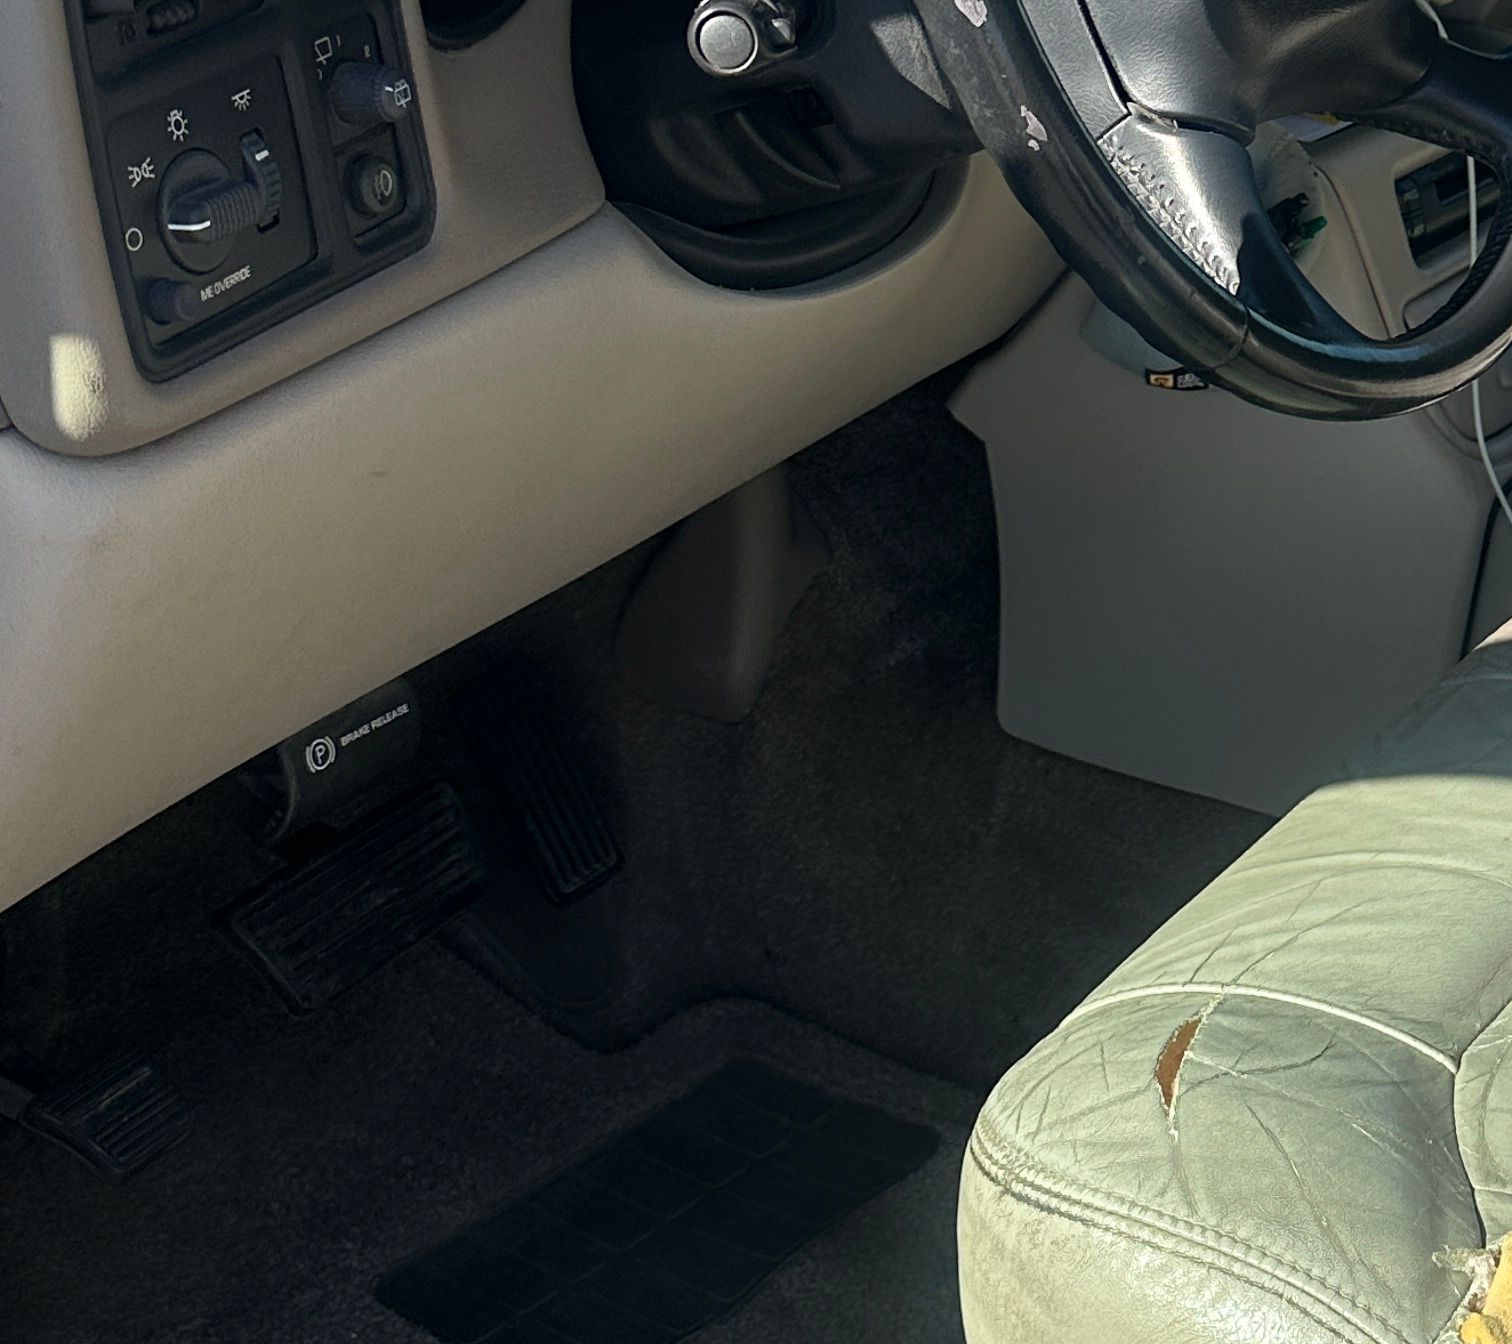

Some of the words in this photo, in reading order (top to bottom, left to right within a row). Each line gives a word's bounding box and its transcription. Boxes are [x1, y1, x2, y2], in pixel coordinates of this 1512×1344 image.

[214, 264, 252, 295] OVERRIDE
[340, 723, 371, 747] BRAKE
[370, 703, 410, 730] RELEASE
